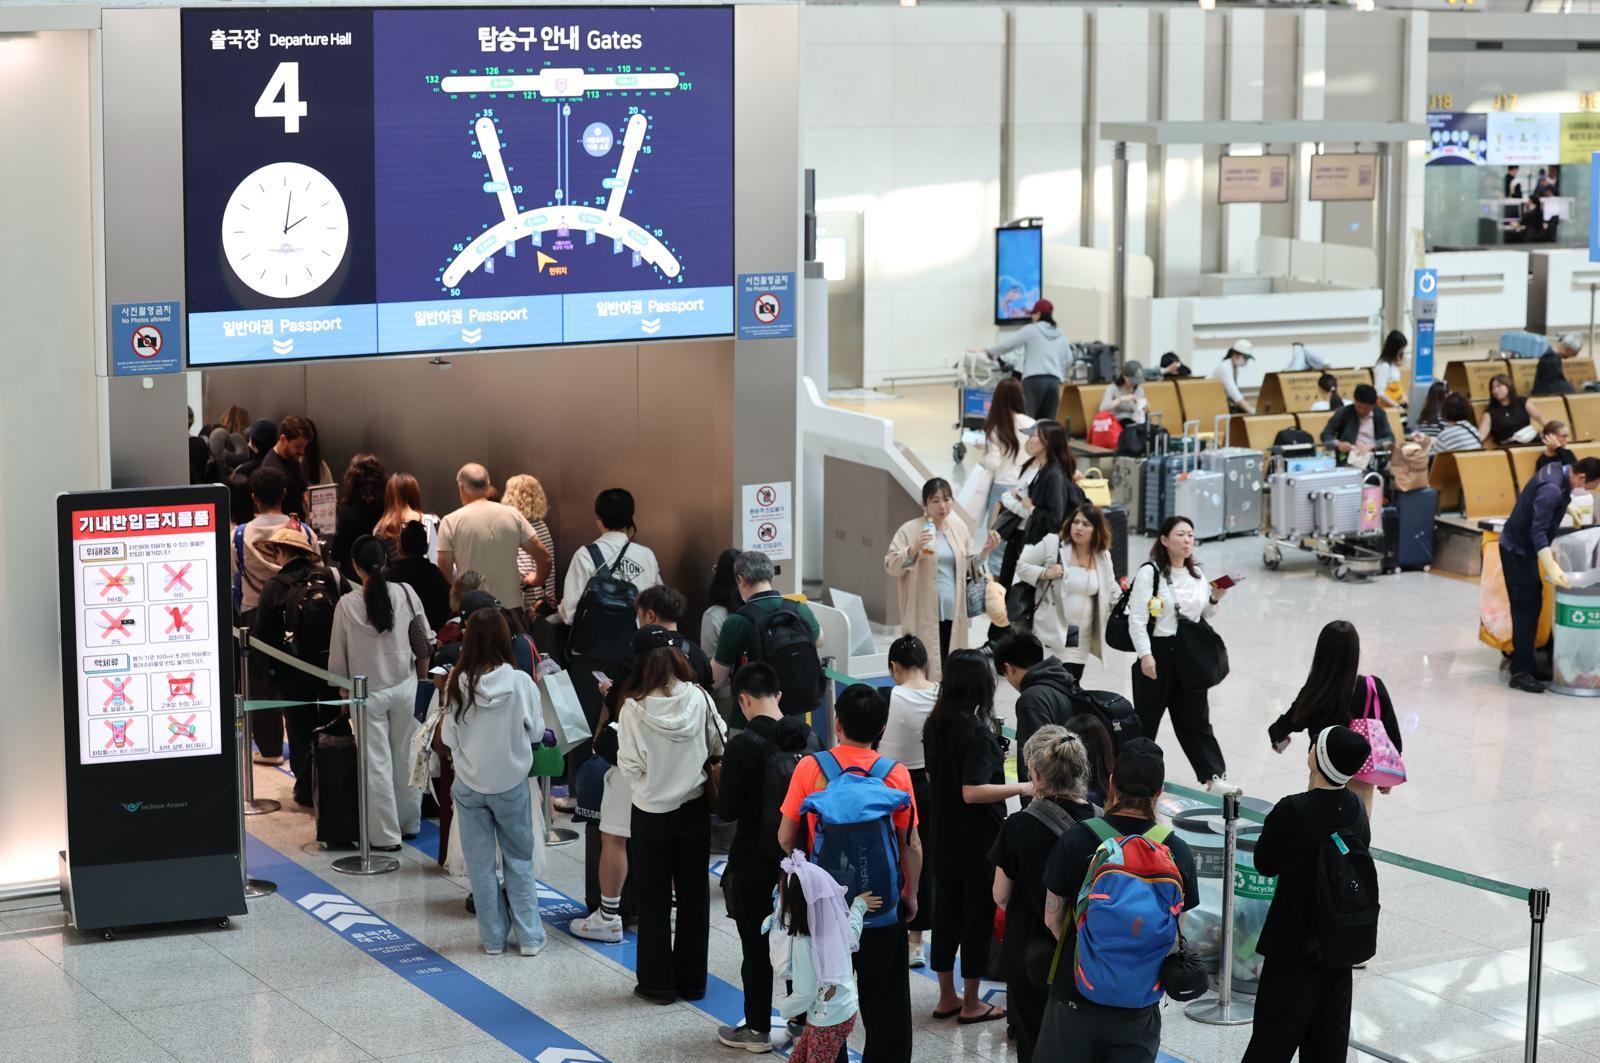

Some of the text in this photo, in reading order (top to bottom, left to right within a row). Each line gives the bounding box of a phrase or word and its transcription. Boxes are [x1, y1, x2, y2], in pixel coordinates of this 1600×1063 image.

[210, 28, 352, 50] 출국장 Departure Hall
[477, 25, 643, 52] 탑승구 안내 Gates
[485, 67, 499, 75] 126
[617, 65, 631, 73] 110
[425, 75, 440, 84] 132
[679, 82, 692, 91] 101
[254, 61, 308, 134] 4
[523, 91, 537, 99] 121
[586, 91, 600, 99] 113
[1429, 94, 1453, 109] J18
[1493, 93, 1518, 110] J17
[482, 109, 493, 117] 35
[628, 106, 639, 114] 20
[642, 146, 652, 154] 15
[471, 151, 482, 159] 40
[512, 186, 523, 194] 30
[595, 197, 606, 205] 25
[653, 229, 663, 237] 10
[453, 243, 464, 251] 45
[653, 265, 658, 273] 1
[677, 275, 683, 283] 5
[450, 288, 460, 296] 50
[122, 305, 171, 317] 사진촬영금지
[596, 298, 705, 317] 일반여권 Passport
[414, 307, 529, 326] 일반여권 Passport
[223, 317, 343, 337] 일반여권 Passport
[79, 510, 209, 533] 기내반입금지물품
[1248, 874, 1275, 886] 재활용
[1248, 884, 1275, 893] Recycle
